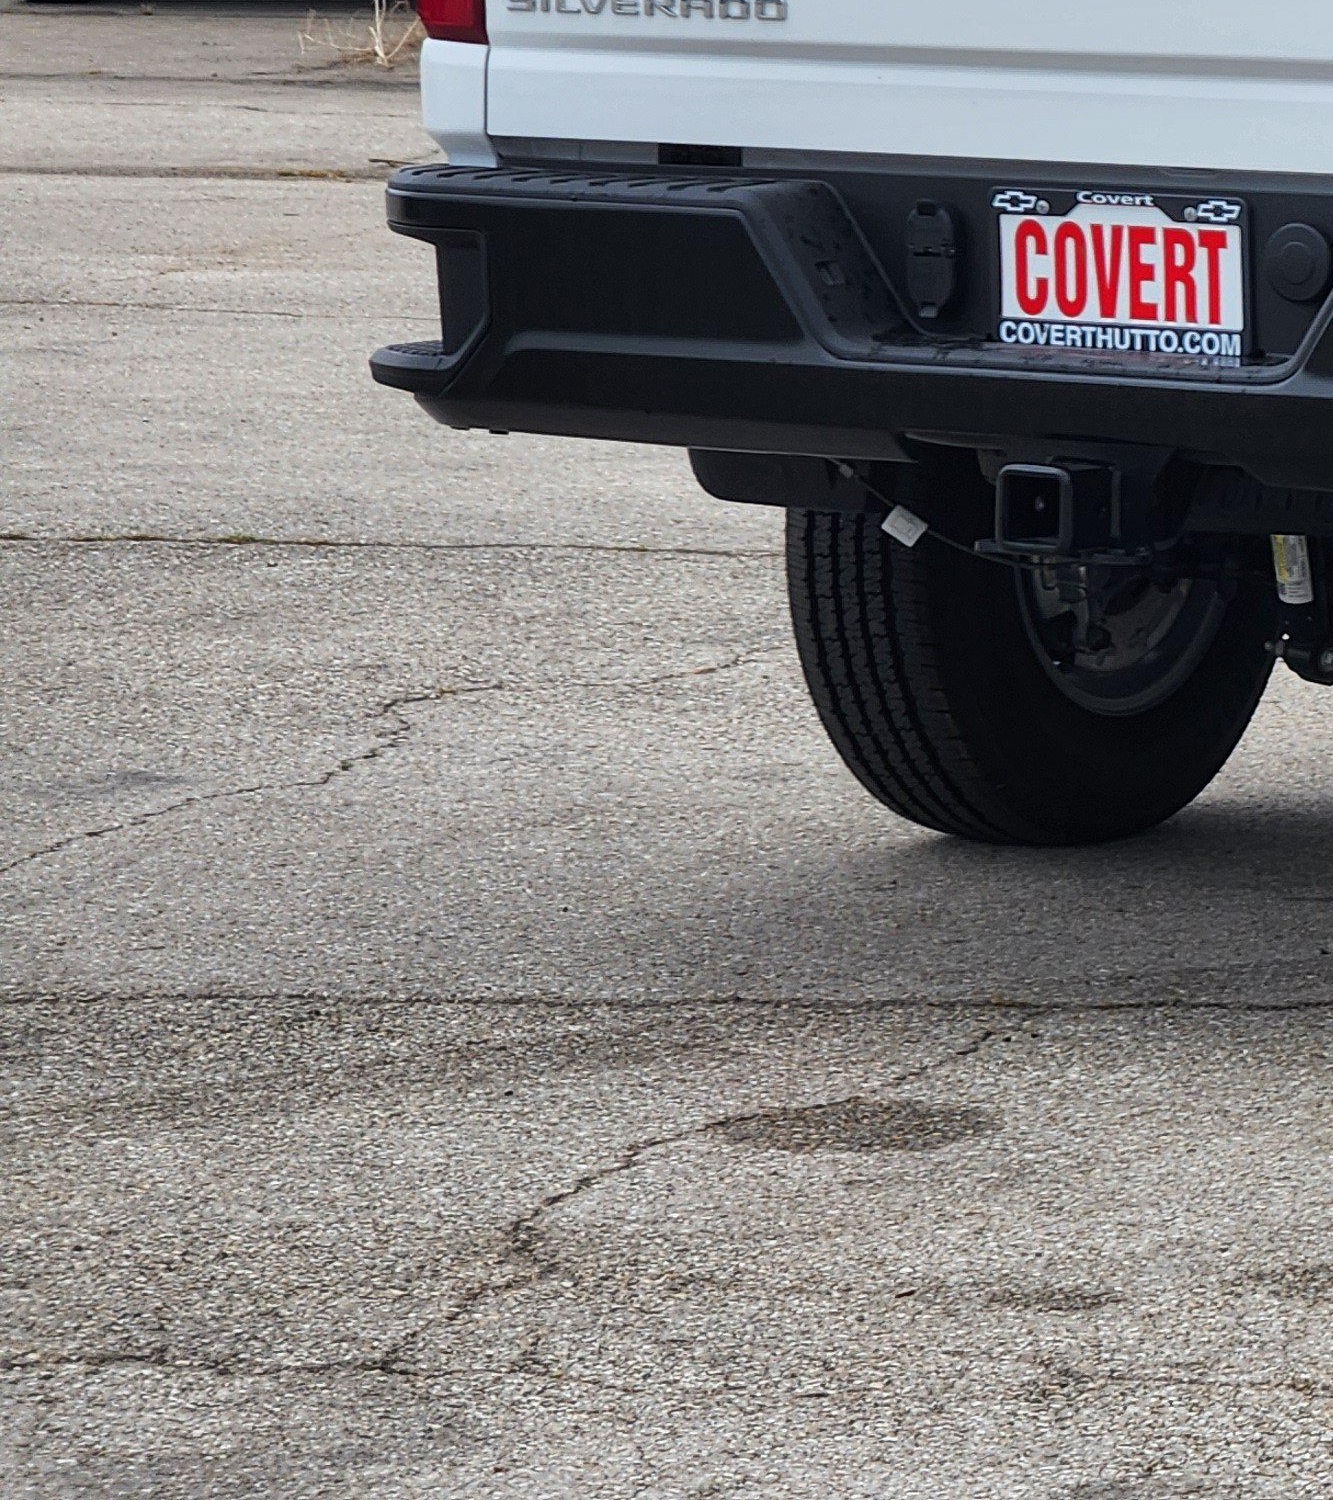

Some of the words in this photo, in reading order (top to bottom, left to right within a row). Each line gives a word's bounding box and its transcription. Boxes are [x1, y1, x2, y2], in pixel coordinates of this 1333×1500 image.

[1076, 190, 1155, 207] Covert
[1015, 218, 1228, 325] COVERT
[999, 320, 1243, 357] COVERTHUTTO.COM
